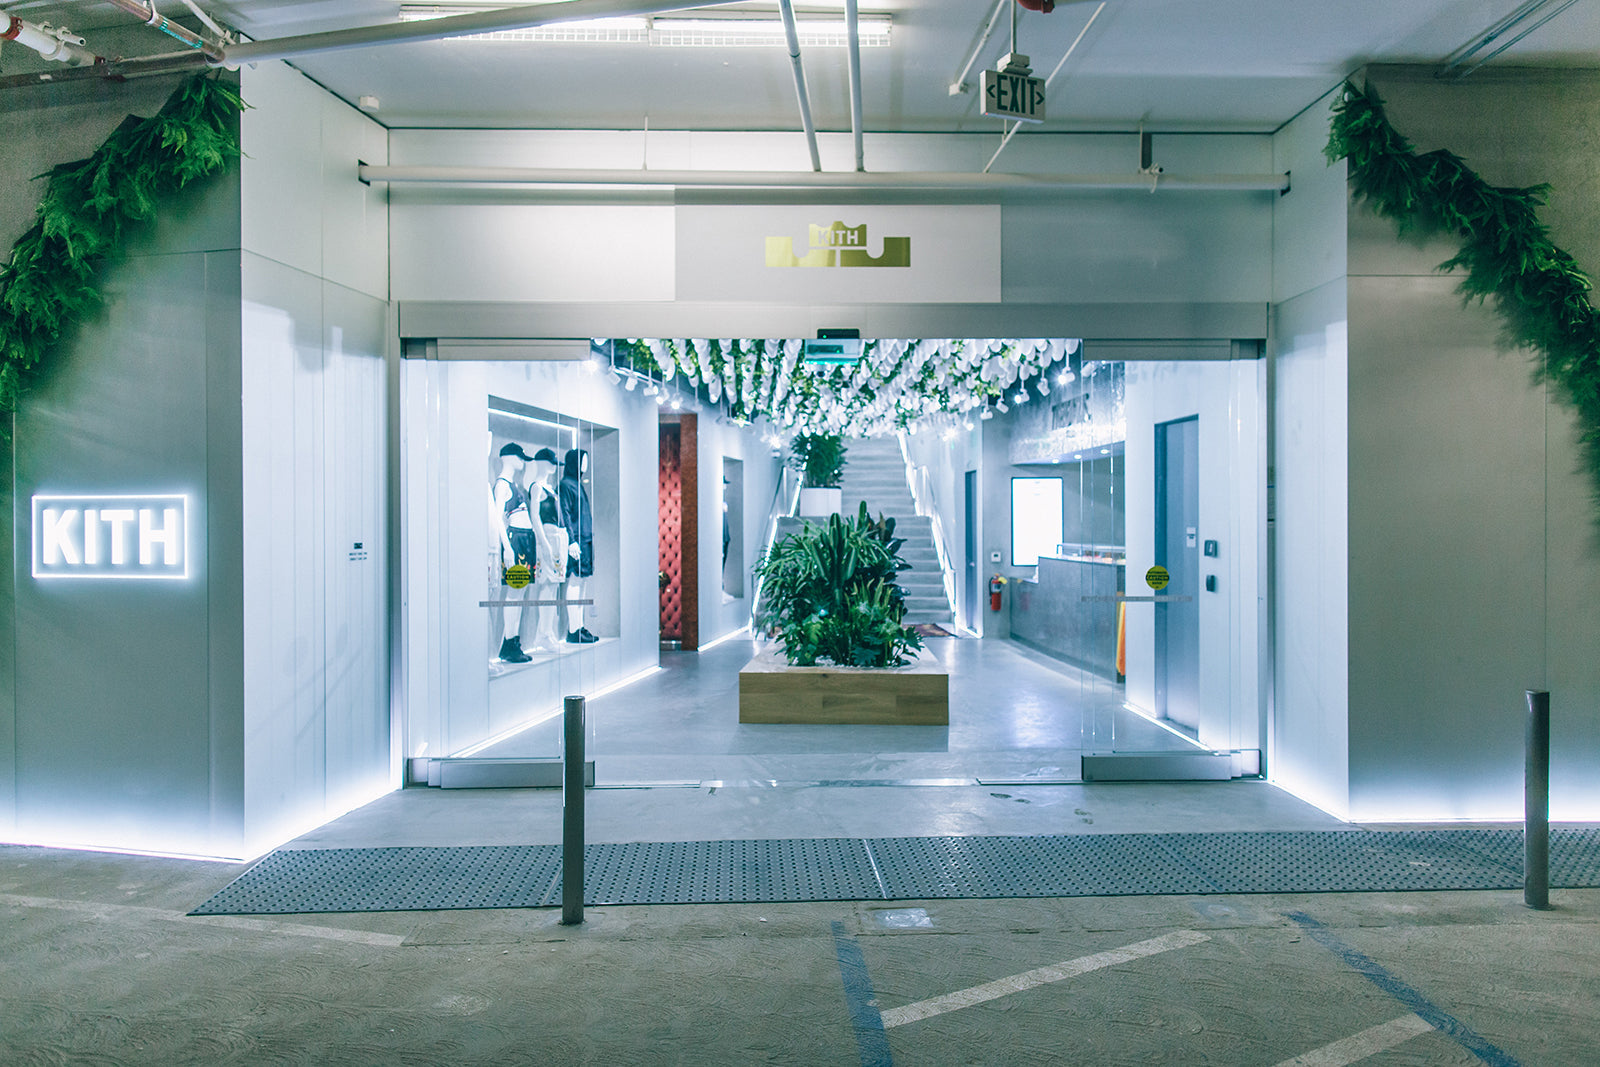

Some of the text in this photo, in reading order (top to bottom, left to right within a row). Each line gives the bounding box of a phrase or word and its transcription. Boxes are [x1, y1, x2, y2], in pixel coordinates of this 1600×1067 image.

[997, 74, 1037, 115] EXIT
[818, 230, 859, 245] KITH
[43, 509, 177, 565] KITH
